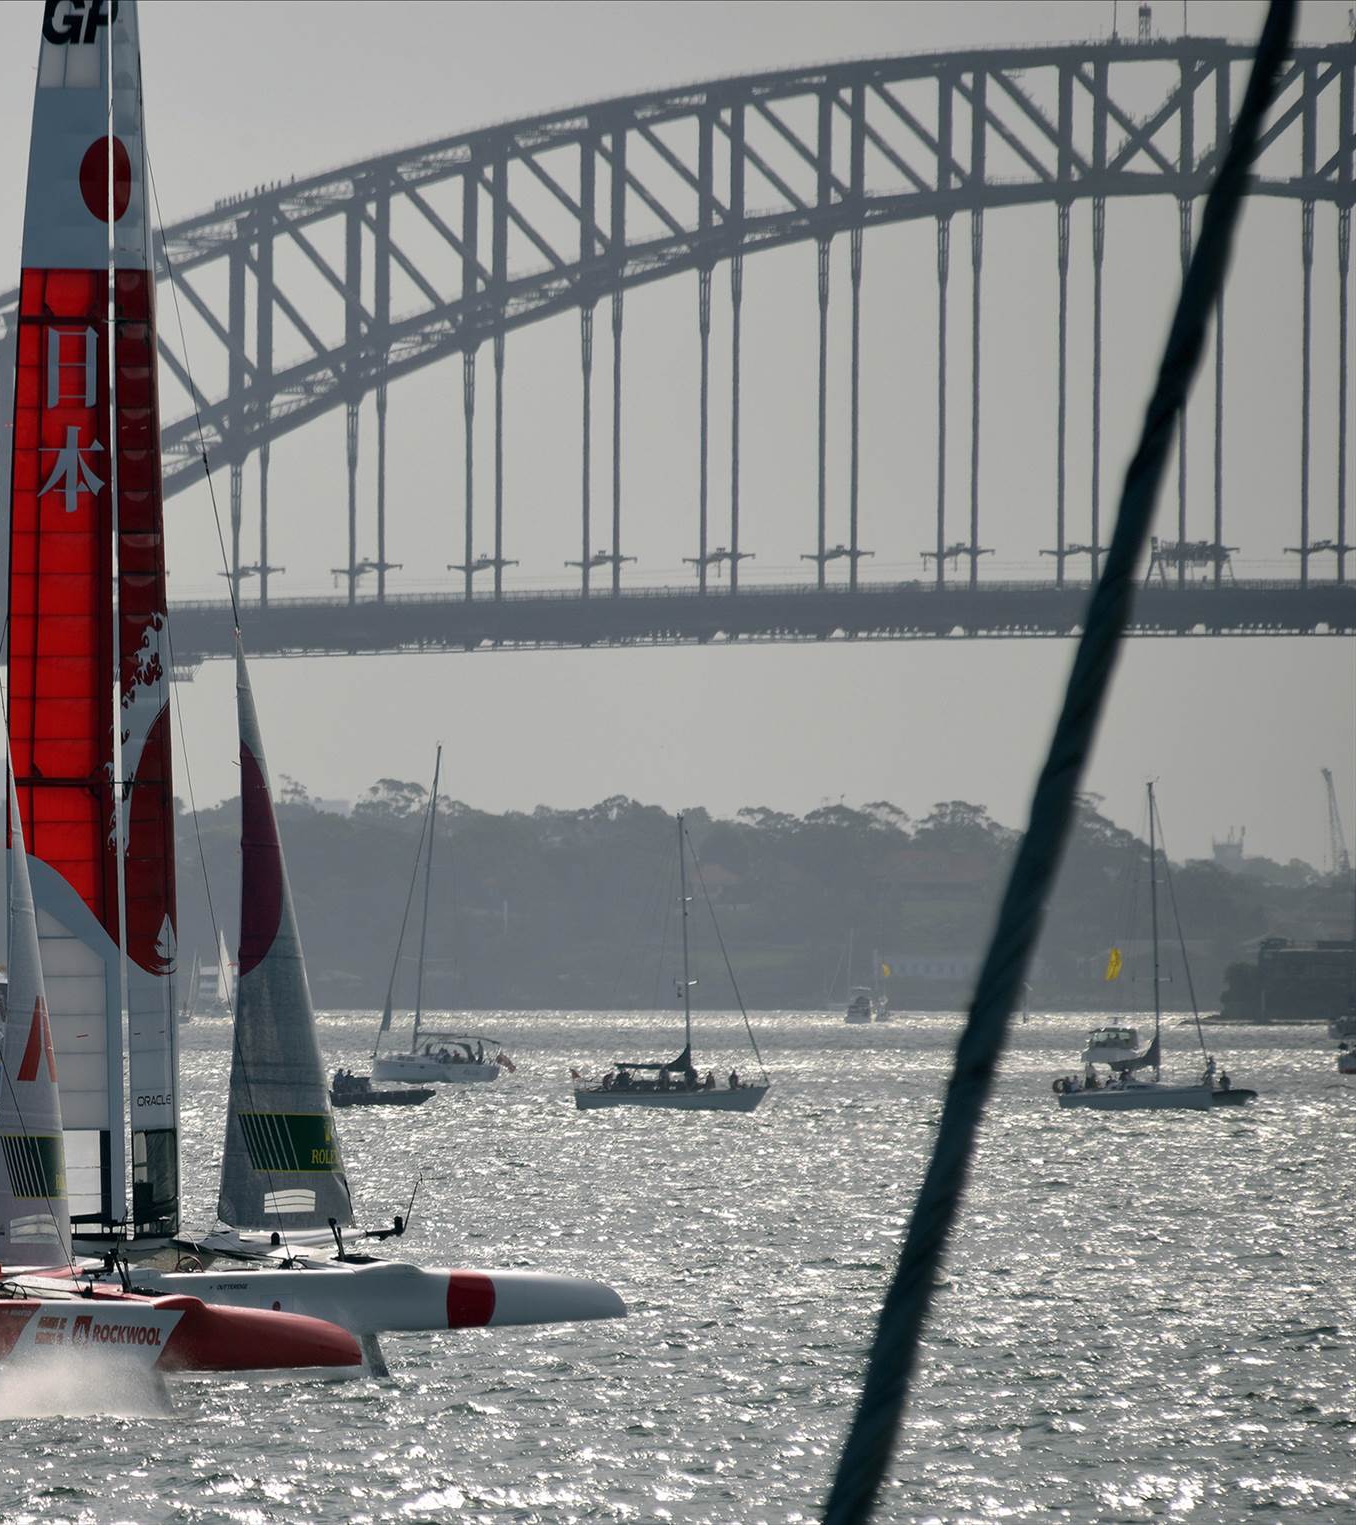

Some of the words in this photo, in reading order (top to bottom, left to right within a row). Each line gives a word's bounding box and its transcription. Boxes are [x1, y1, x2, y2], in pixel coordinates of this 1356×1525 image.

[42, 0, 119, 45] GP
[37, 326, 105, 512] 日本
[137, 1094, 171, 1107] ORACLE
[311, 1149, 340, 1164] ROLE
[93, 1323, 161, 1346] ROCKWOOL
